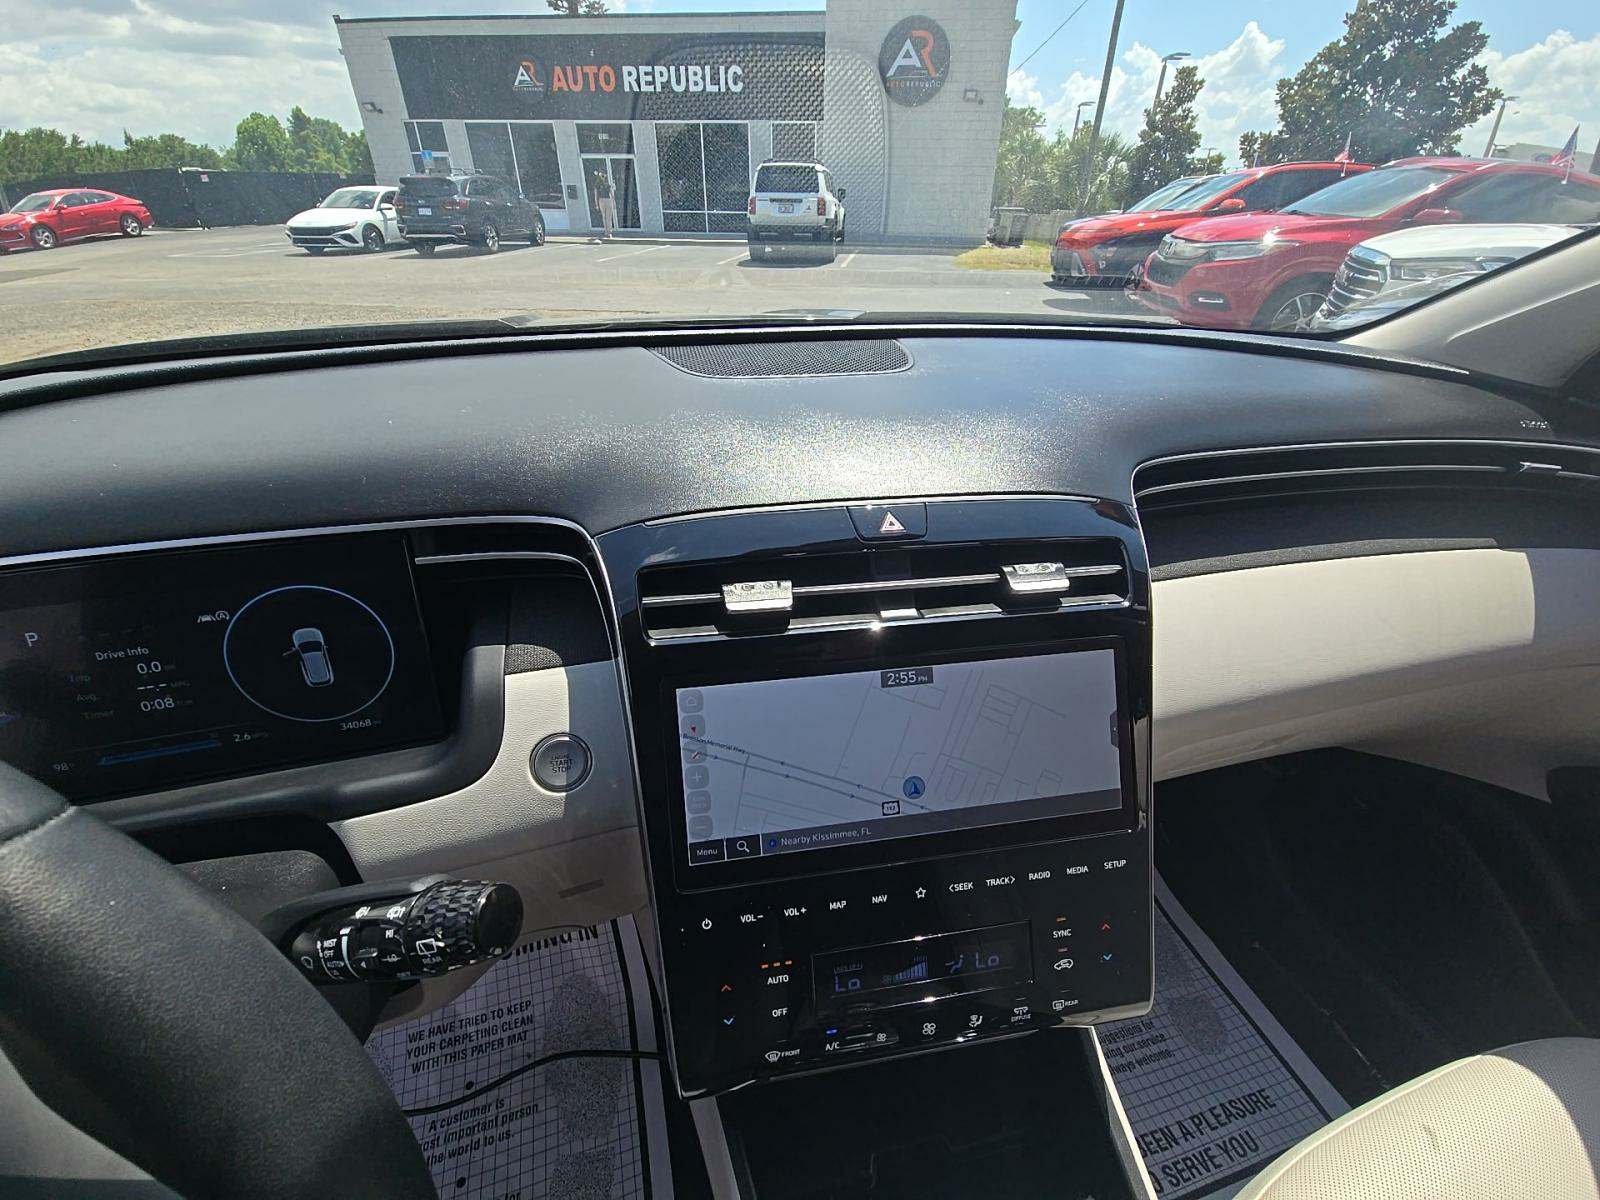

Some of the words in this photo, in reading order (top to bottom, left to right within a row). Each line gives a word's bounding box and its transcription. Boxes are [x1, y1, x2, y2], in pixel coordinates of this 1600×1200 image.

[553, 65, 616, 92] AUTO
[622, 65, 744, 92] REPUBLIC
[25, 632, 38, 647] P
[95, 650, 125, 661] Drive
[128, 646, 150, 657] Info
[137, 661, 162, 675] 0.0
[887, 670, 917, 686] 2:55
[140, 697, 175, 712] 0:08
[340, 719, 372, 731] 34068
[233, 733, 251, 742] 2.6
[781, 832, 811, 846] Nearby
[812, 828, 859, 843] Kissimmee,
[861, 827, 871, 836] FL
[696, 846, 718, 856] Menu
[1066, 865, 1089, 876] MEDIA
[1103, 859, 1127, 870] SETUP
[1028, 870, 1051, 881] RADIO
[829, 900, 847, 911] MAP
[871, 894, 888, 904] NAV
[1052, 928, 1072, 938] SYNC
[767, 974, 789, 985] AUTO
[772, 1008, 788, 1017] OFF
[408, 1029, 424, 1044] WE
[428, 1022, 455, 1039] HAVE
[460, 1013, 488, 1030] TRIED
[492, 1007, 504, 1019] TO
[507, 1000, 531, 1015] KEEP
[1140, 1020, 1153, 1031] for
[407, 1043, 435, 1060] YOUR
[439, 1025, 498, 1050] CARPETING
[502, 1015, 533, 1032] CLEAN
[412, 1057, 439, 1074] WITH
[443, 1049, 467, 1064] THIS
[471, 1039, 504, 1057] PAPER
[507, 1030, 528, 1046] MAT
[825, 1041, 840, 1051] A/C
[428, 1120, 438, 1133] A
[439, 1106, 492, 1129] customer
[495, 1098, 504, 1110] is
[1176, 1120, 1195, 1142] A
[1190, 1088, 1276, 1135] PLEASURE
[443, 1119, 499, 1144] important
[502, 1104, 538, 1125] person
[448, 1139, 481, 1159] world
[483, 1135, 495, 1147] to
[497, 1131, 515, 1144] us.
[1162, 1147, 1223, 1188] SERVE
[1216, 1130, 1260, 1163] YOU
